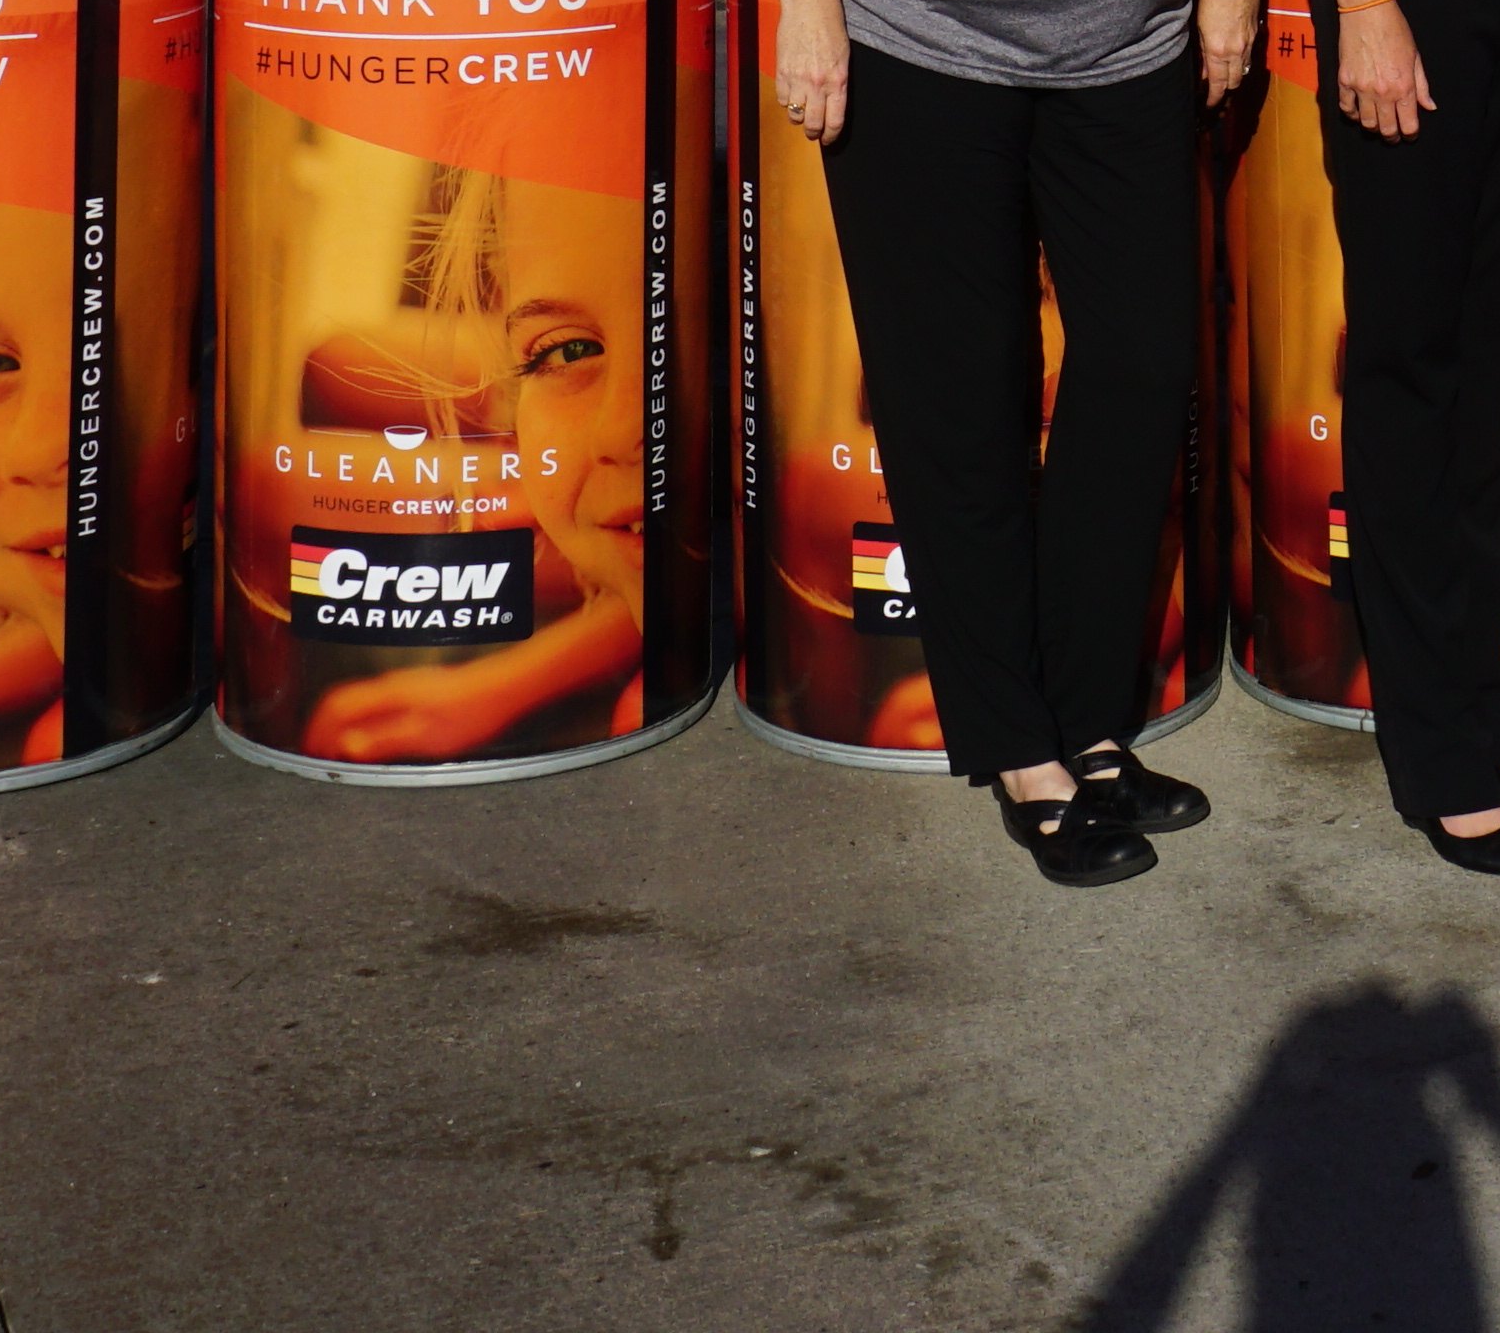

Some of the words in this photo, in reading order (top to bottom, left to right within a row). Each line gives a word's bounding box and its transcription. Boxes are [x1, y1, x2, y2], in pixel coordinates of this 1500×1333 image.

[256, 47, 593, 85] #HUNGERCREW
[276, 446, 559, 484] GLEANERS
[312, 495, 508, 515] HUNGERCREW.COM
[317, 548, 510, 603] Crew
